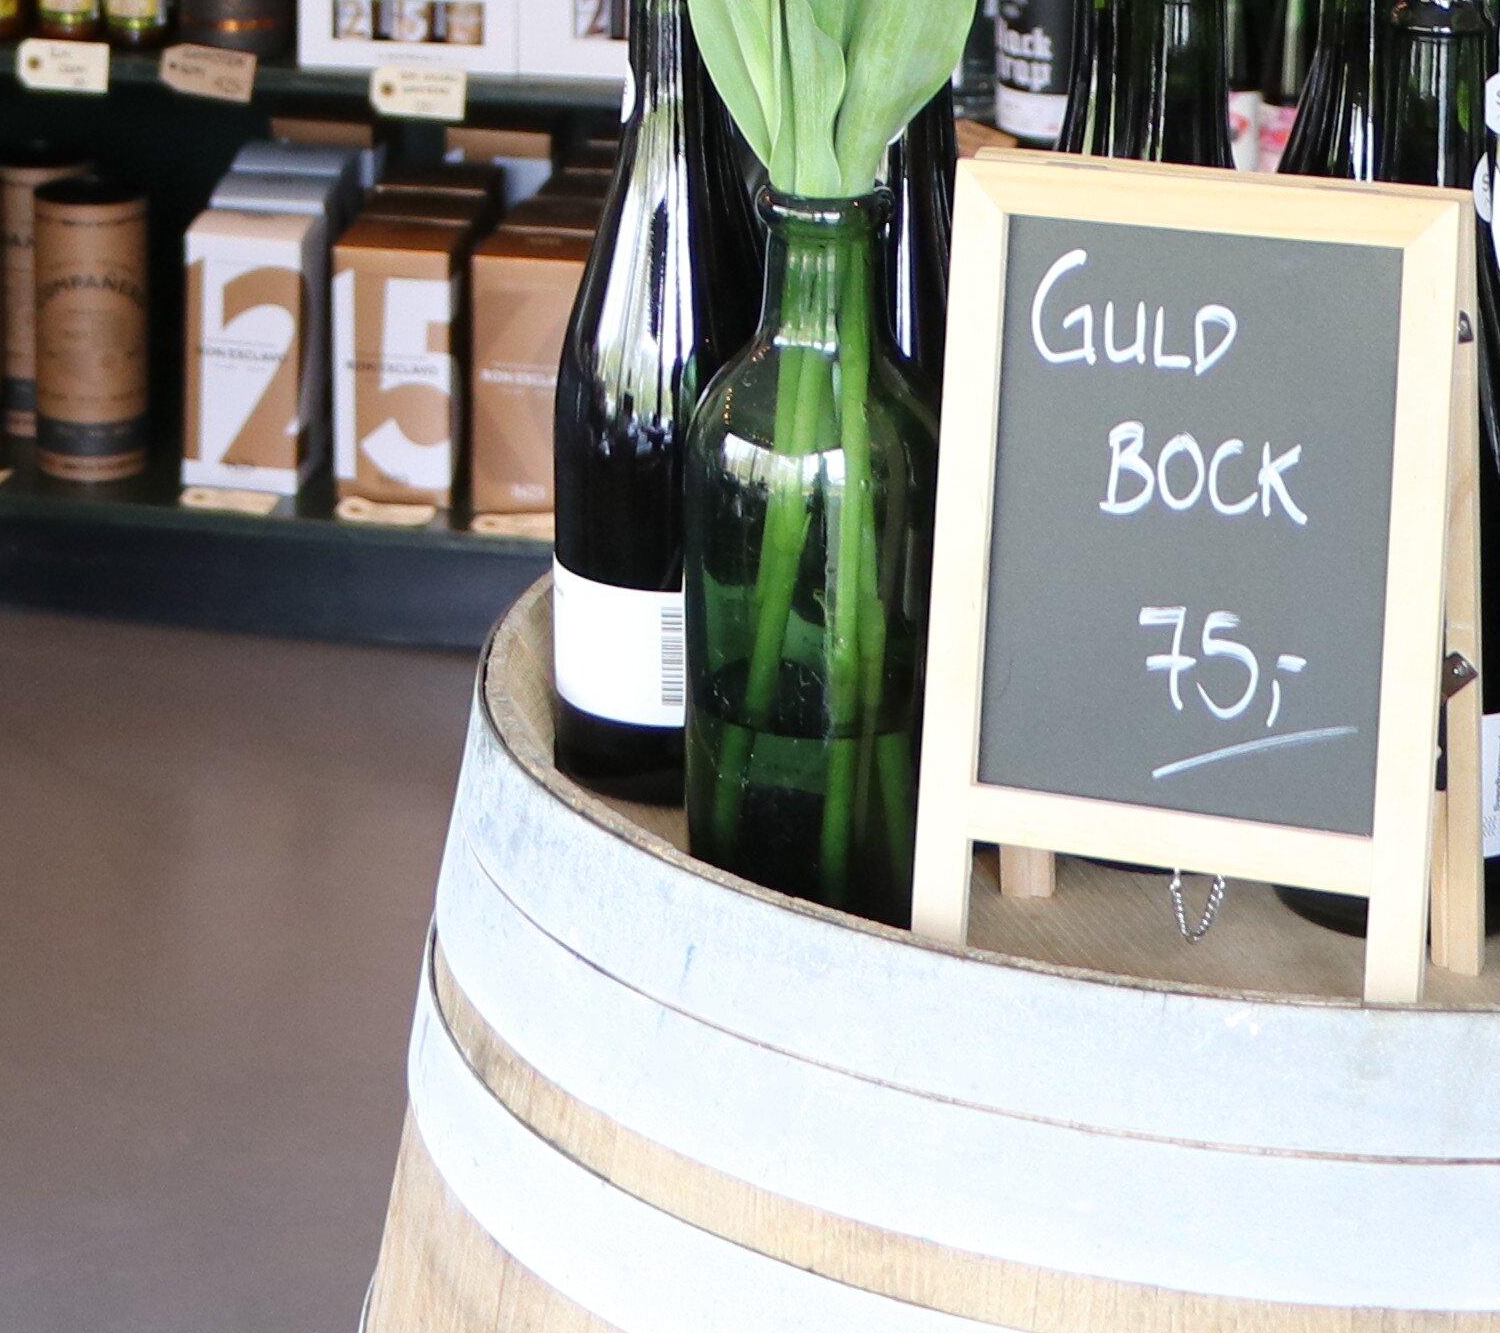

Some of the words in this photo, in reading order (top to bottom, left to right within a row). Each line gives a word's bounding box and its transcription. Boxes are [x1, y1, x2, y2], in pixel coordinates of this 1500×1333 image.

[1031, 248, 1238, 378] GULD
[1098, 420, 1309, 526] BOCK
[1137, 605, 1306, 728] 75,-
